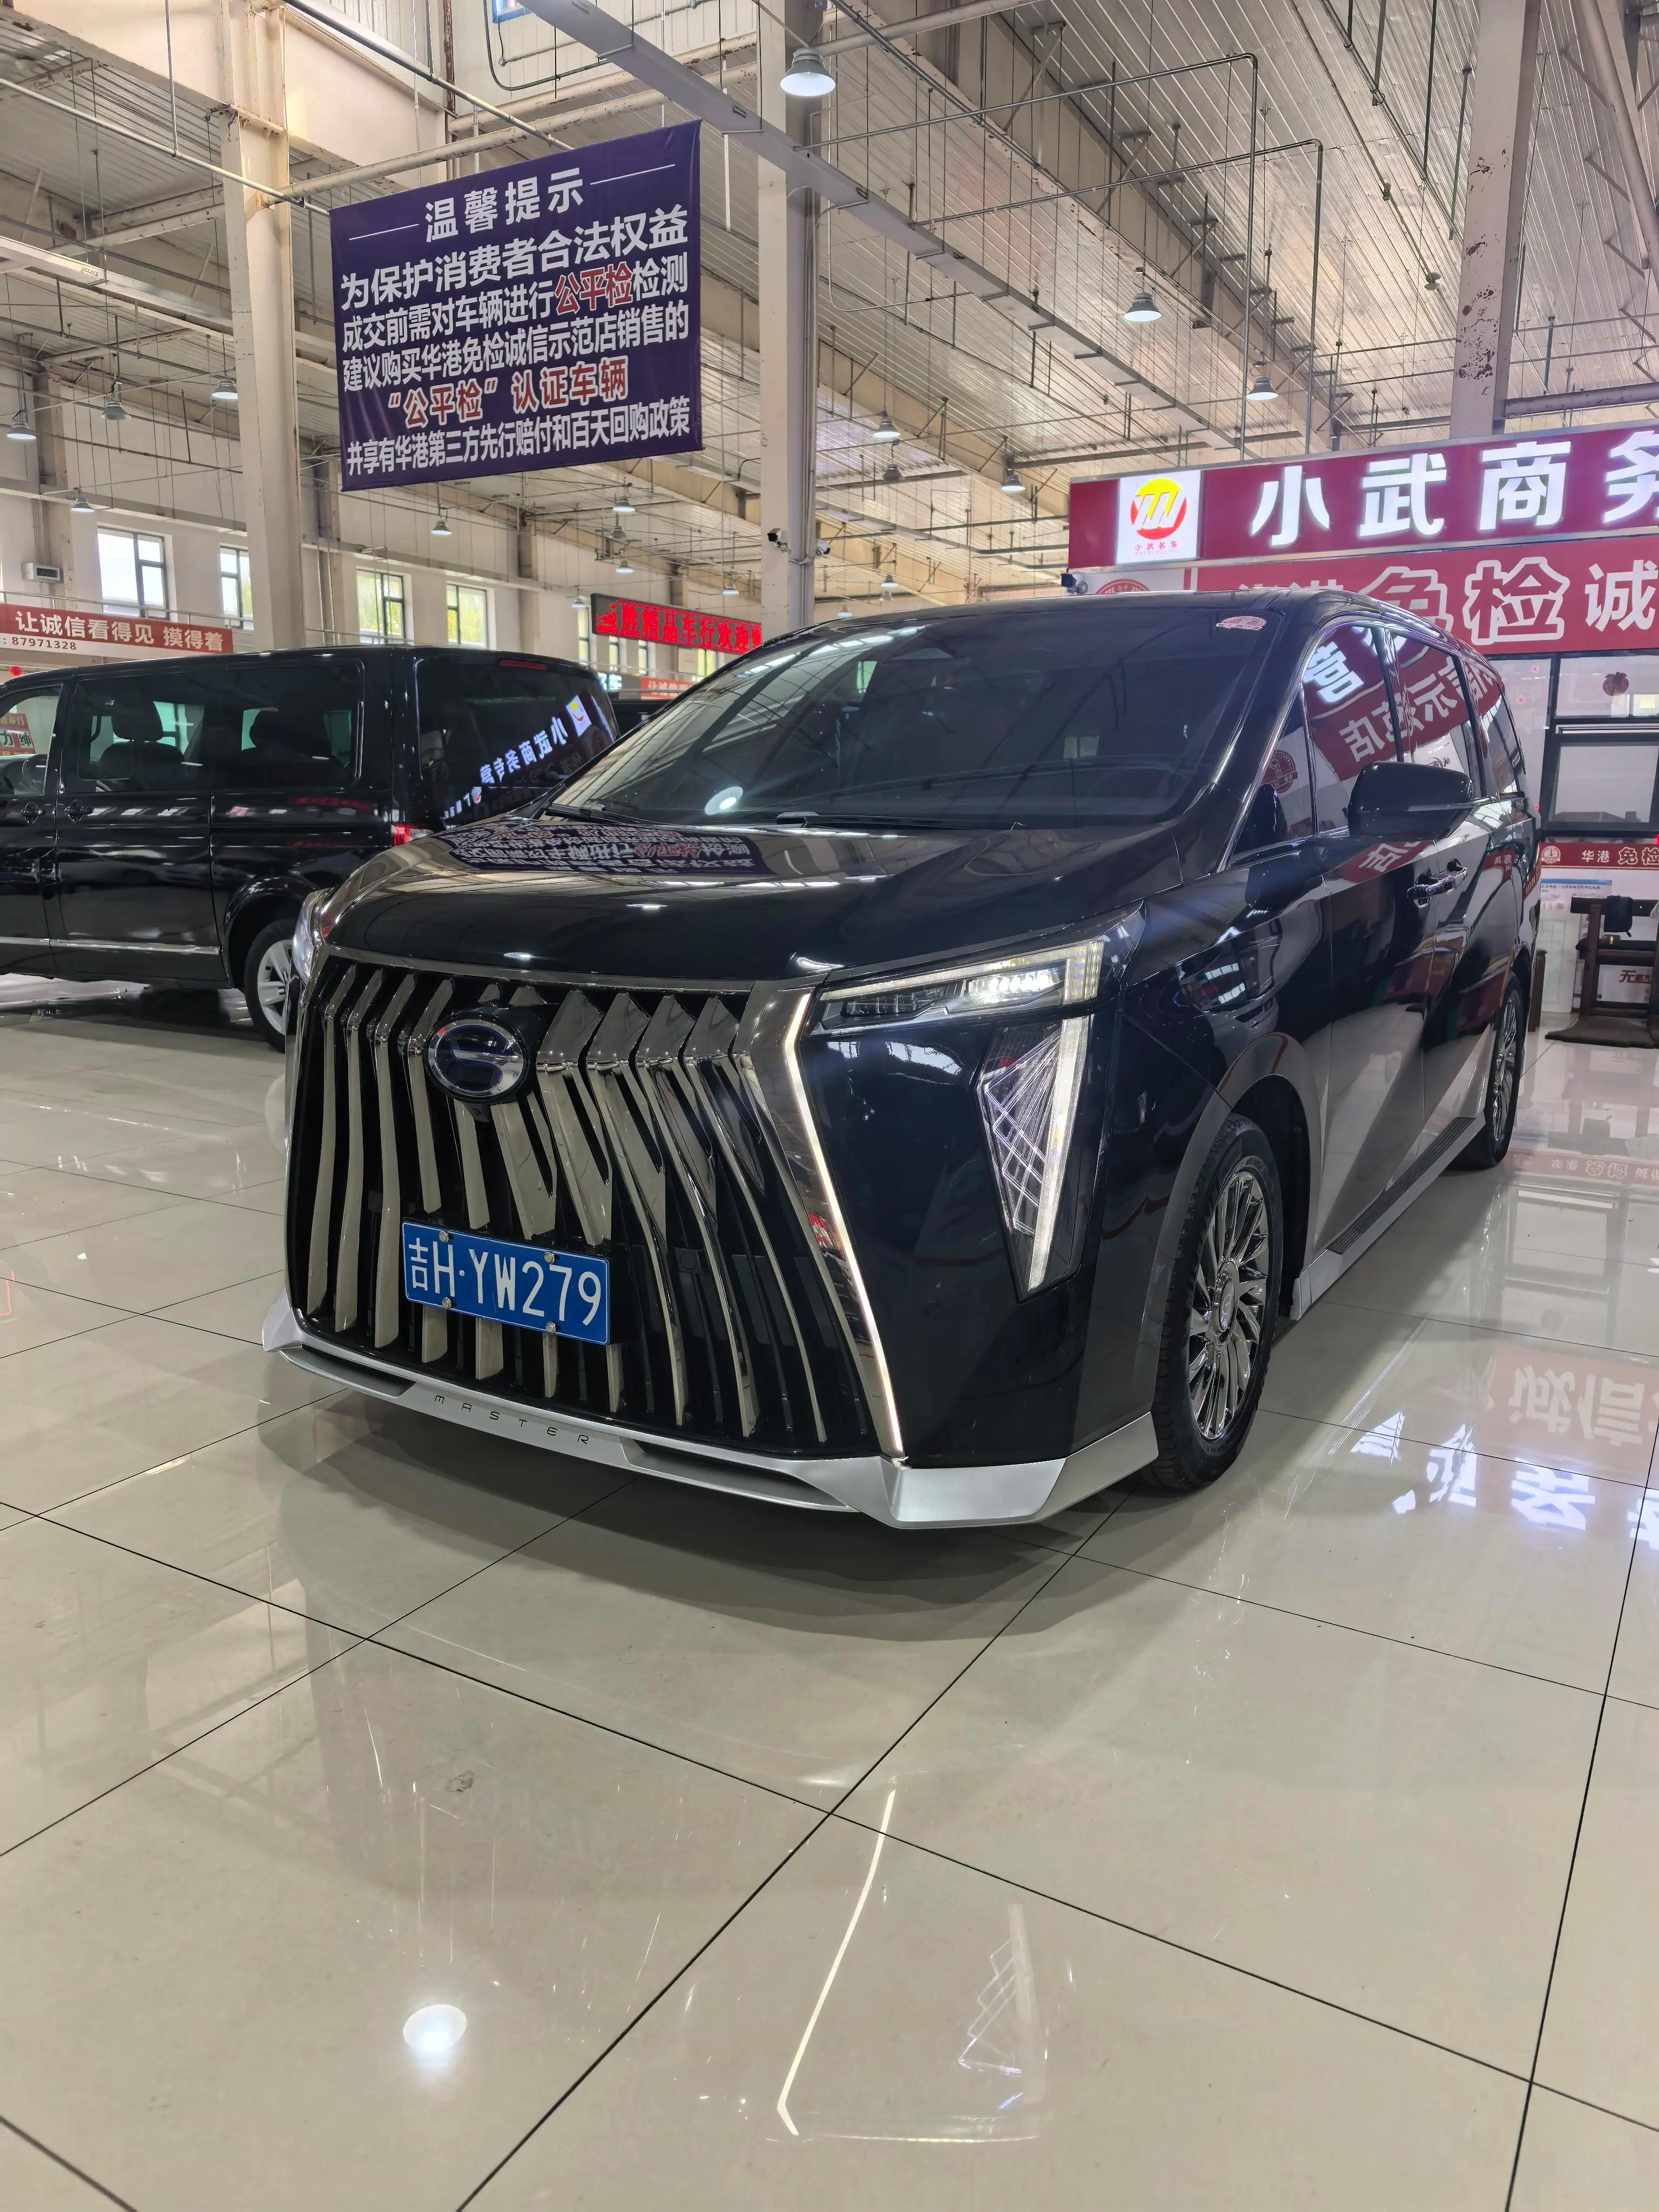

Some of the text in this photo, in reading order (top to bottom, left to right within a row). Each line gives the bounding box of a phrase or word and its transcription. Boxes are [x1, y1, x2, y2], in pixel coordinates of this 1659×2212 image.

[426, 167, 583, 242] 温馨提示
[341, 205, 689, 311] 为保护消费者合法权益
[342, 251, 689, 352] 成交前需对车辆进行公平检检测
[343, 301, 689, 393] 建议购买华港免检诚信示范店销售的
[511, 355, 628, 414] 认证车辆
[347, 395, 691, 476] 并享有华港第三方先行赔付和百天回购政策
[1249, 430, 1659, 547] 小武商务
[15, 610, 224, 652] 让诚信看得见 摸得着
[434, 1394, 589, 1445] MASTER
